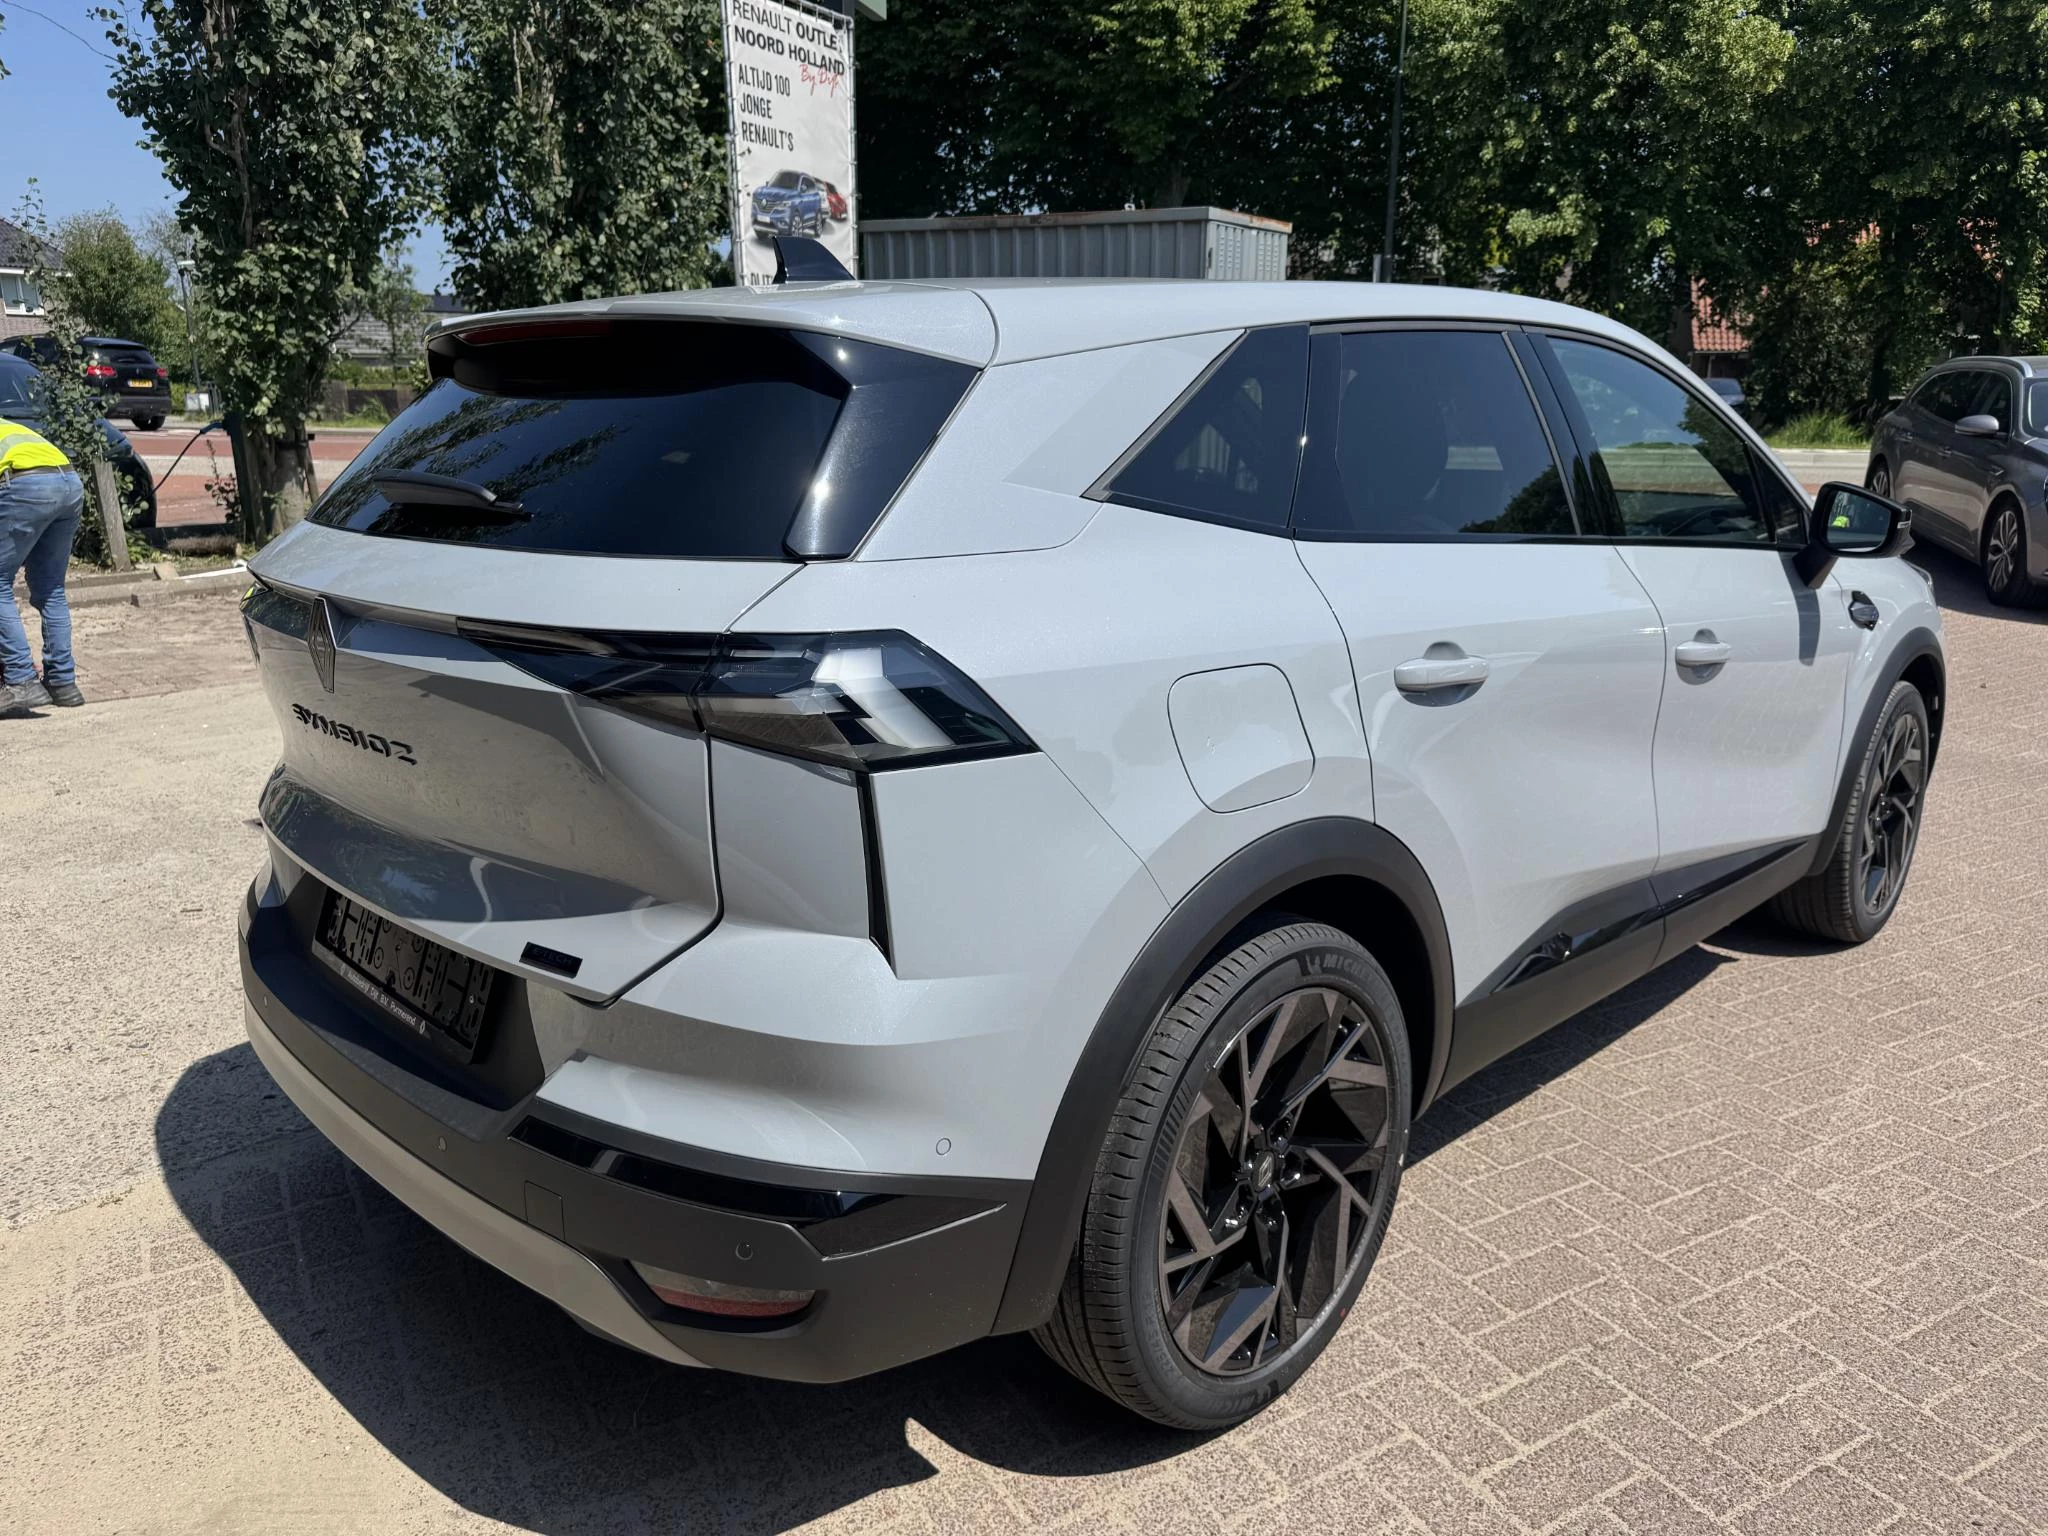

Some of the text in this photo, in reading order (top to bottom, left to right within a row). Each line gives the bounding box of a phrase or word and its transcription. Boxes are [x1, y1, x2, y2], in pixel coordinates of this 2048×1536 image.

[732, 0, 842, 53] RENAULT OUTLE
[734, 25, 845, 76] NOORD HOLLAND
[739, 64, 791, 97] ALTIJD 100
[740, 93, 772, 119] JONGE
[742, 121, 793, 152] RENAULT'S
